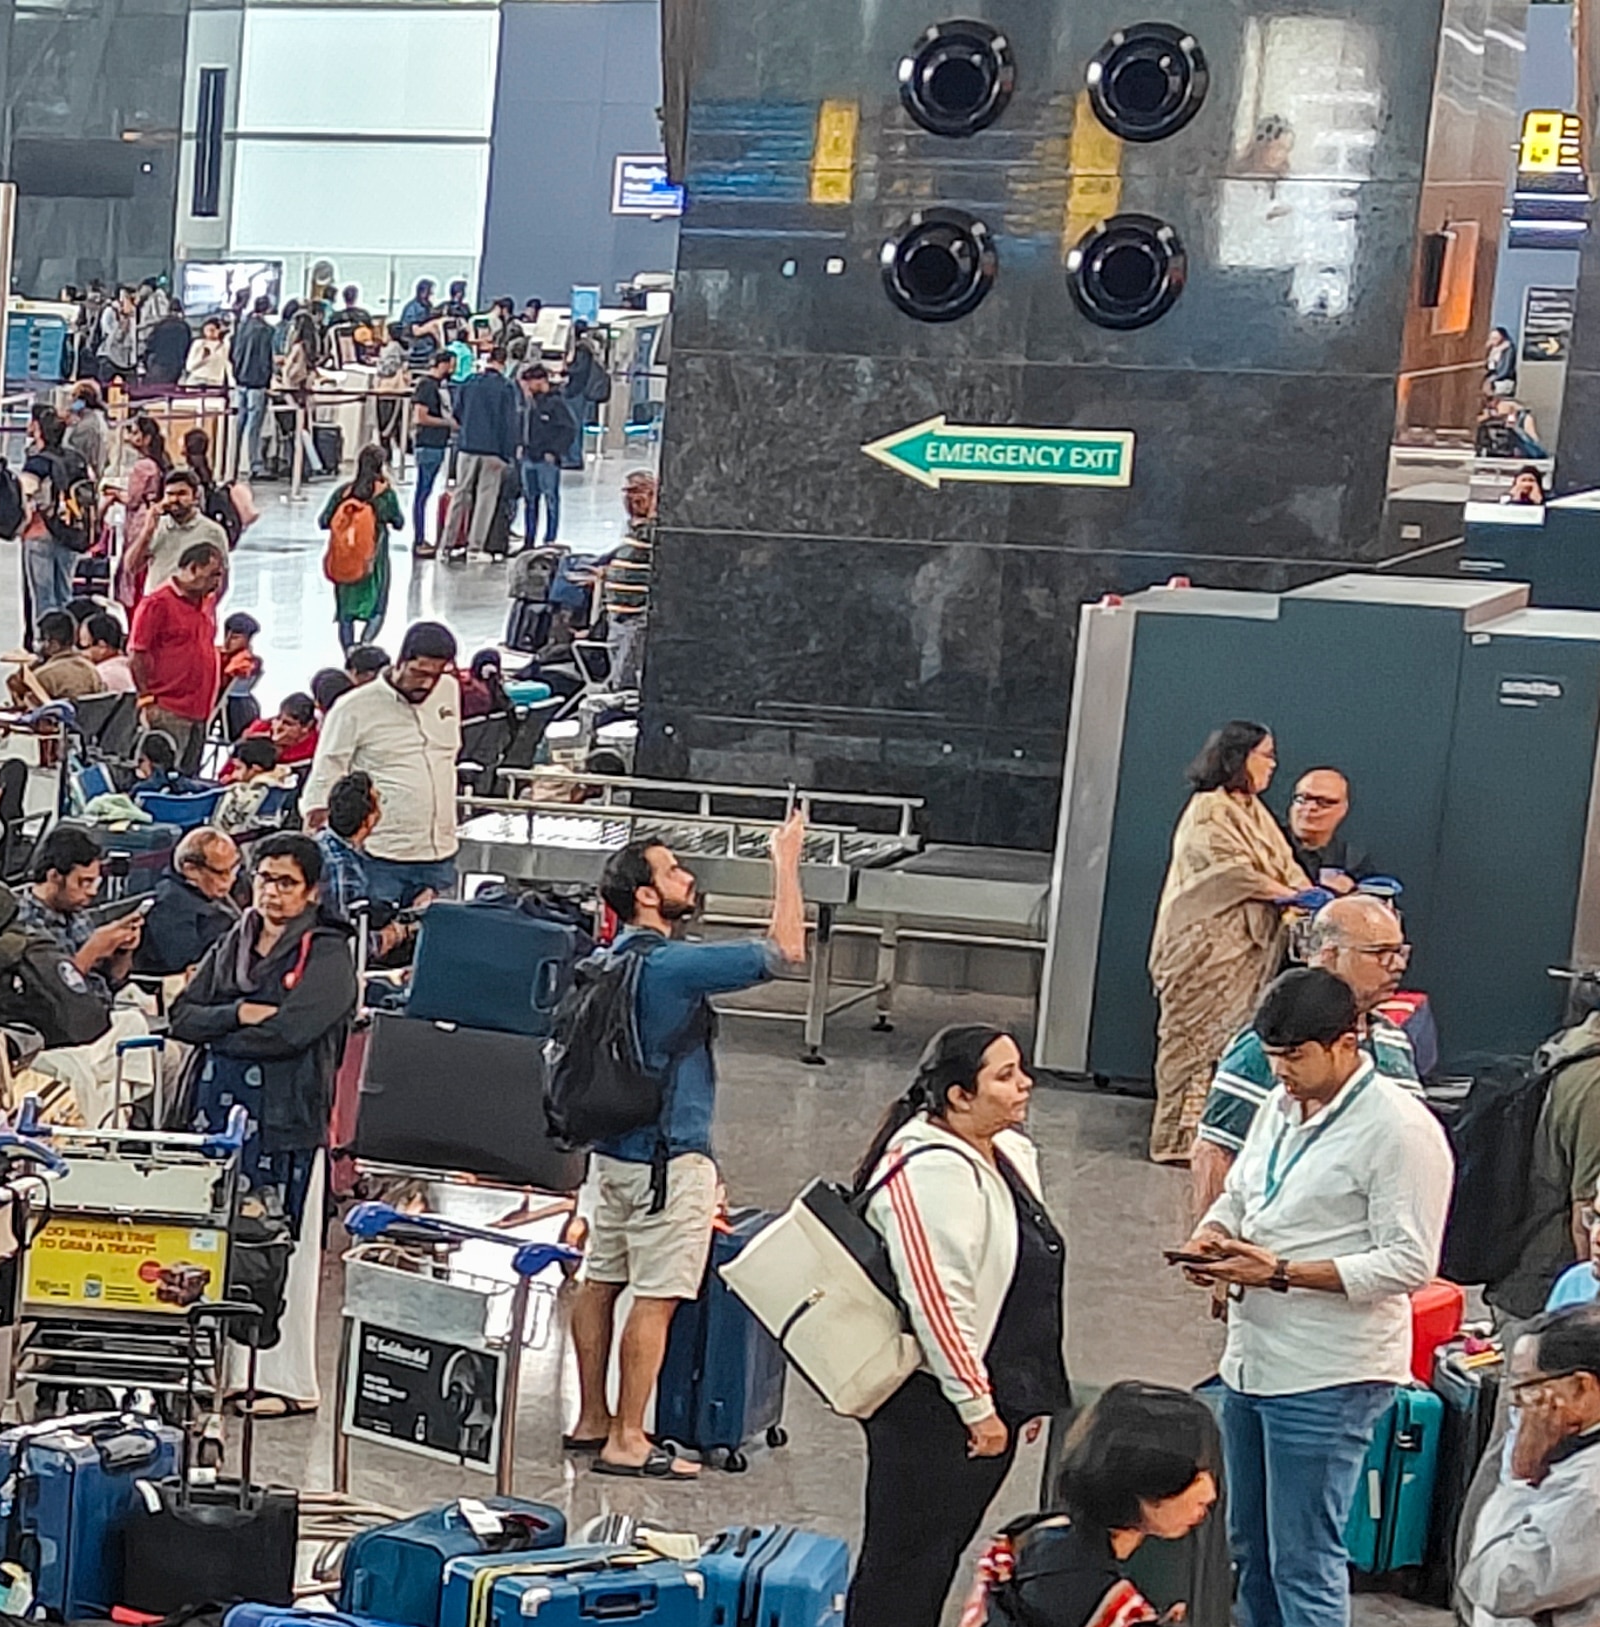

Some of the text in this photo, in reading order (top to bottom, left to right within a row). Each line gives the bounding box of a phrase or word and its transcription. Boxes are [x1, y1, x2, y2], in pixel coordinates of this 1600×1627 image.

[924, 441, 1119, 469] EMERGENCY EXIT
[92, 1230, 123, 1242] HAVE
[127, 1232, 157, 1244] TIME
[40, 1238, 56, 1249] TO
[60, 1239, 93, 1252] GRAB
